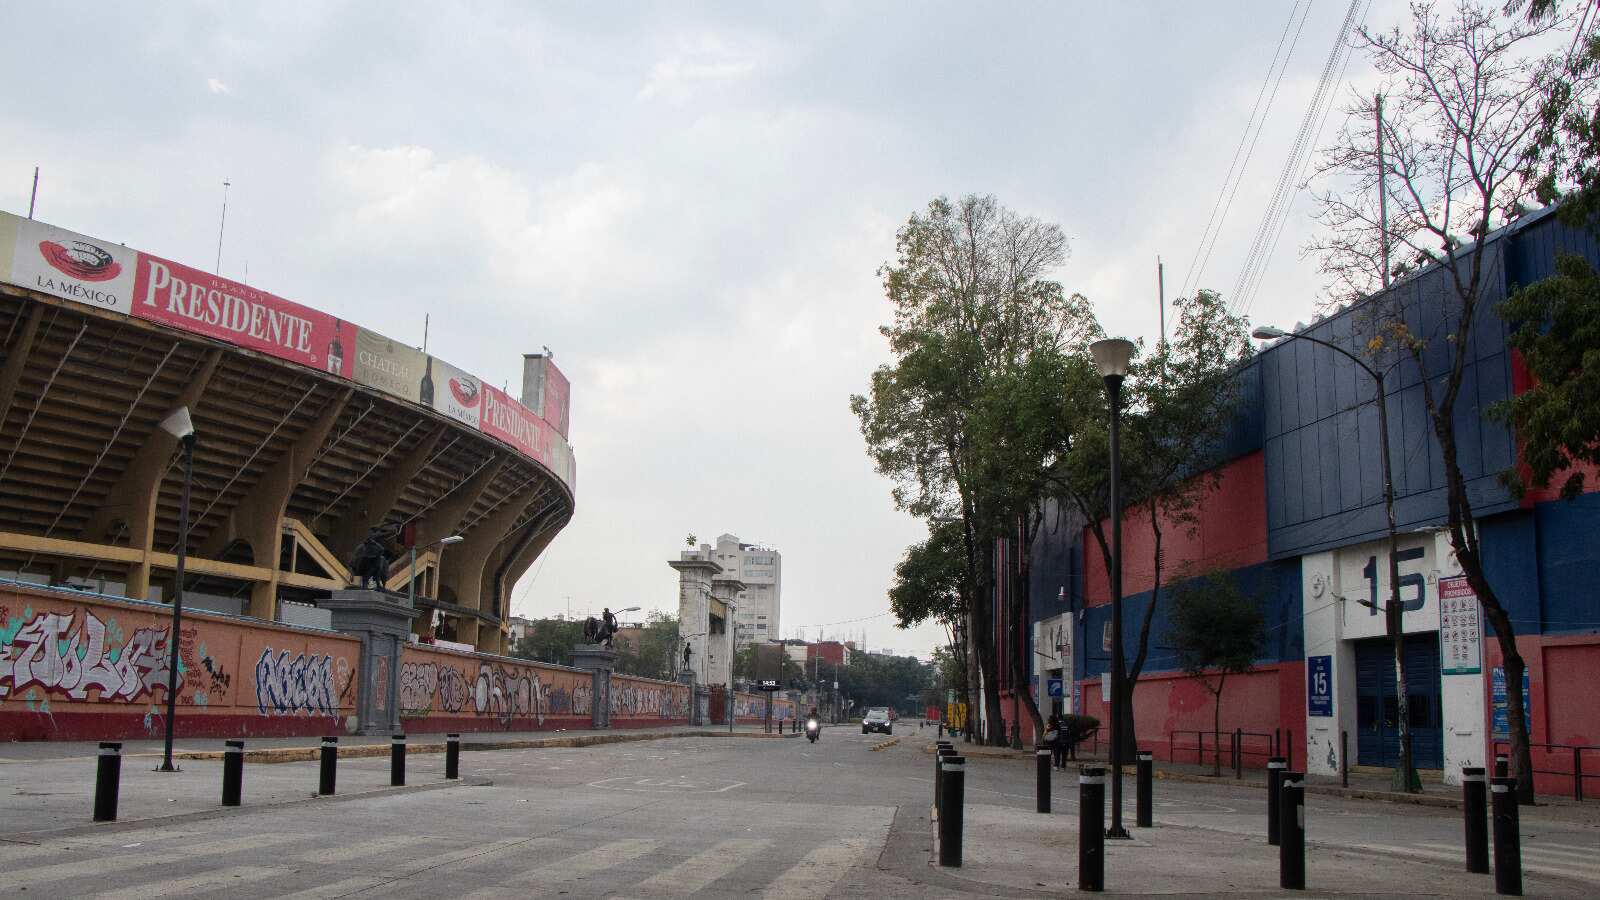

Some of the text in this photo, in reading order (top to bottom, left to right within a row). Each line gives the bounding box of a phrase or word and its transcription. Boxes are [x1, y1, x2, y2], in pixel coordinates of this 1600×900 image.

[37, 275, 117, 306] LA MÉXICO
[143, 260, 313, 352] PRESIDENTE
[483, 388, 542, 453] PRESIDENTE
[1363, 546, 1426, 616] 15
[1313, 672, 1327, 695] 15
